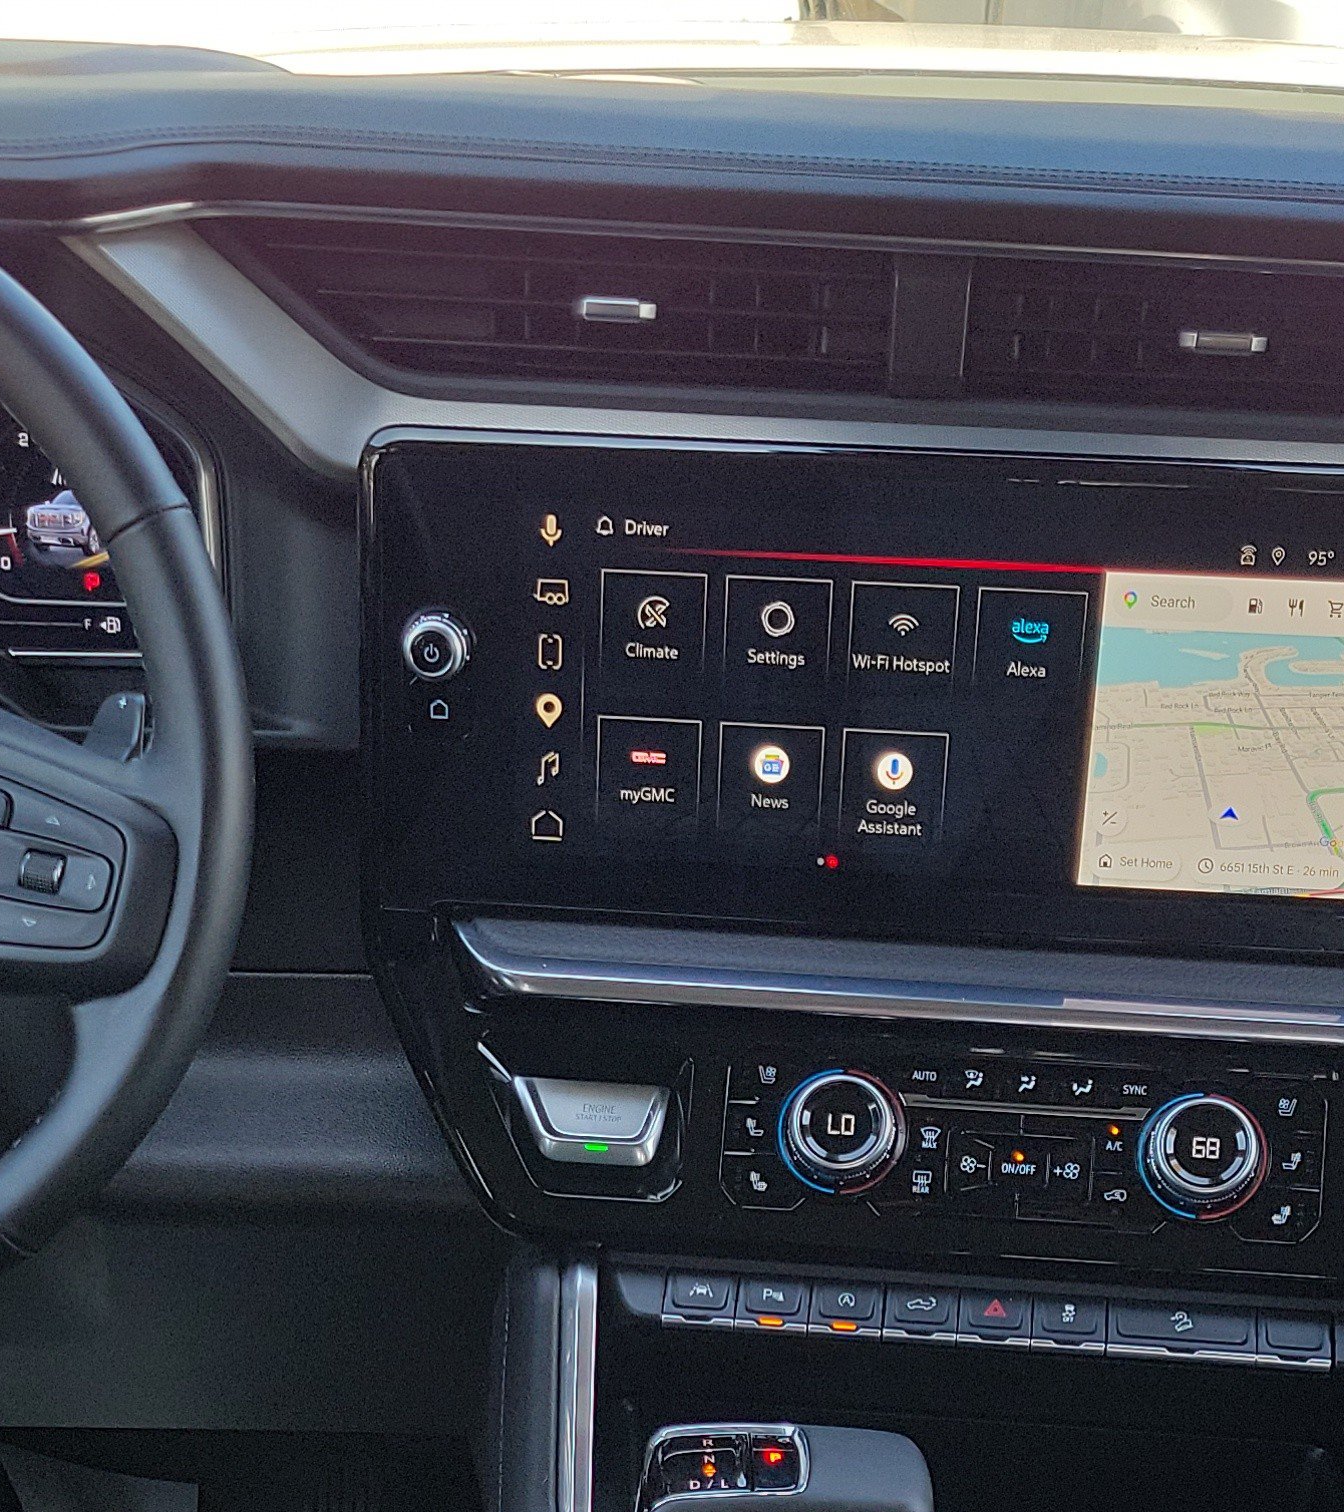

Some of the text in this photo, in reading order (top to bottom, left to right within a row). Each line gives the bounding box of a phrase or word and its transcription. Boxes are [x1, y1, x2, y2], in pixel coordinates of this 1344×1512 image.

[17, 432, 29, 447] 2
[624, 519, 670, 537] Driver
[0, 556, 11, 570] 0
[1308, 550, 1335, 567] 95°
[1151, 595, 1196, 610] Search
[1011, 619, 1050, 636] alexa
[625, 642, 679, 660] Climate
[747, 649, 805, 669] Settings
[852, 653, 950, 675] Wi-Fi Hotspot
[1006, 661, 1047, 679] Alexa
[620, 787, 675, 804] myGMC
[751, 794, 789, 809] News
[866, 799, 917, 817] Google
[857, 820, 923, 837] Assistant
[1120, 856, 1173, 869] Set Home
[1220, 862, 1339, 877] 6651 15th St E 26 min
[912, 1070, 937, 1081] AUTO
[1122, 1084, 1148, 1096] SYNC
[583, 1103, 616, 1114] ENGINE
[575, 1113, 598, 1122] START
[1106, 1140, 1123, 1152] A/C
[1000, 1162, 1037, 1176] ON/OFF
[702, 1438, 714, 1447] R
[703, 1454, 715, 1464] N
[768, 1451, 782, 1463] P
[689, 1478, 730, 1490] D L
